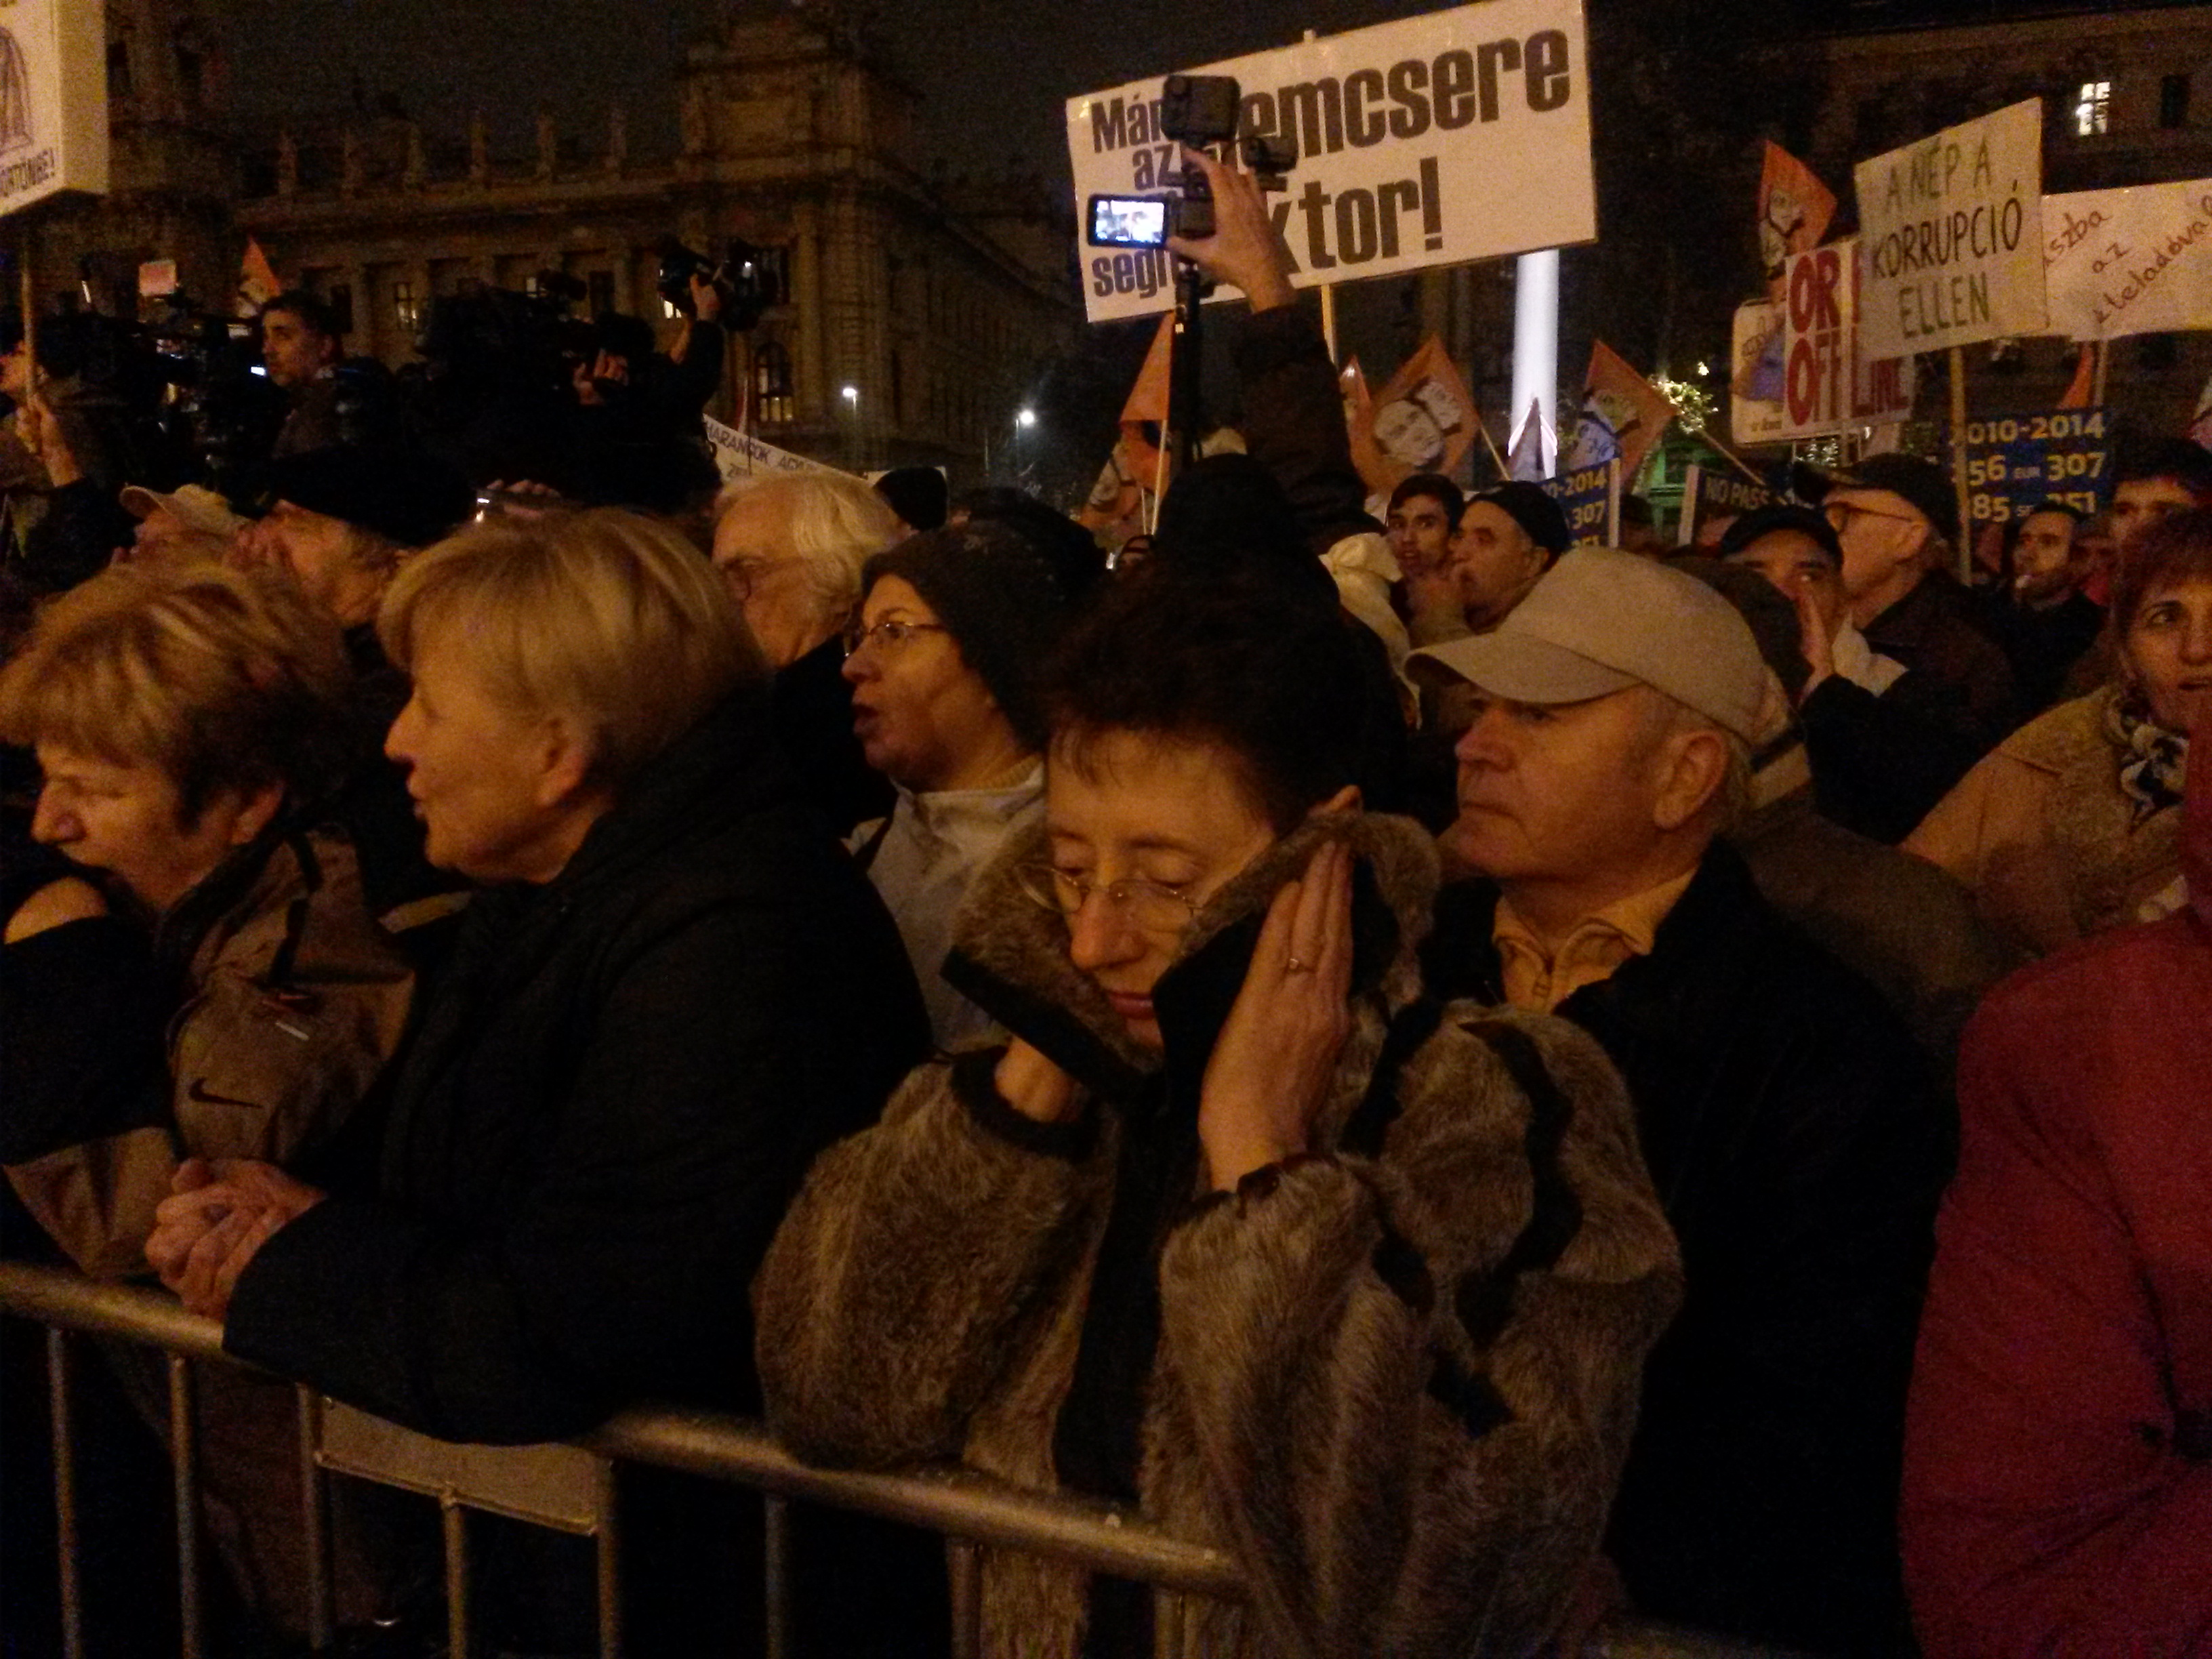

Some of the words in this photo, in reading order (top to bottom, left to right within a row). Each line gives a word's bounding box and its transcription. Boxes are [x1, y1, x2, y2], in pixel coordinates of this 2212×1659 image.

[1236, 29, 1571, 159] emcsere
[1885, 166, 1903, 213] A
[1910, 136, 1963, 204] NÉP
[1973, 136, 1992, 188] A
[1269, 157, 1443, 274] ktor!
[1872, 178, 2023, 279] KORRUPCIÓ
[2091, 242, 2133, 274] az
[1900, 271, 1990, 340] ELLEN
[1954, 411, 2106, 445] 010-2014
[1954, 455, 2007, 487] 56
[2046, 452, 2106, 482] 307
[1572, 499, 1606, 530] 307
[1971, 493, 2011, 523] 85
